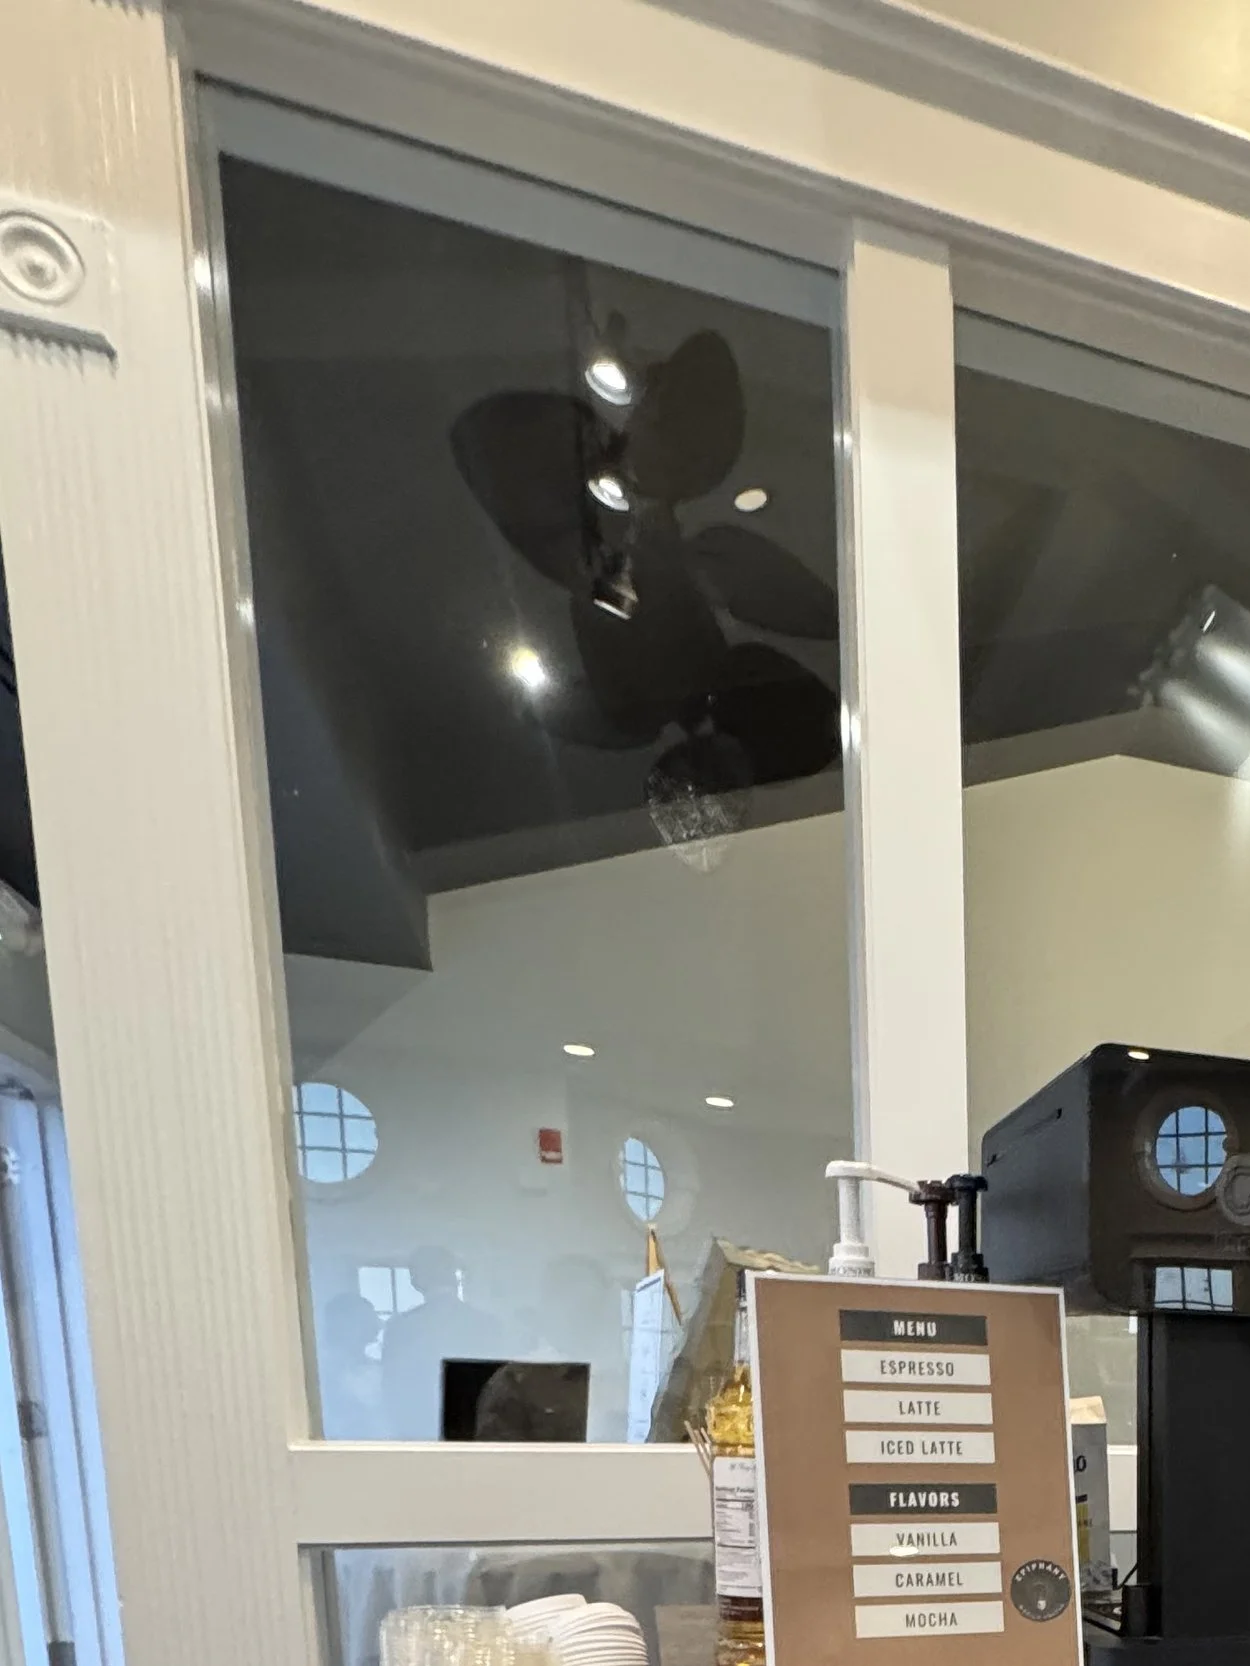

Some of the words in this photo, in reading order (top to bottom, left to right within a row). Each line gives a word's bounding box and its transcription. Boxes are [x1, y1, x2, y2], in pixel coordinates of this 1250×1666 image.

[893, 1319, 937, 1337] MENU
[880, 1359, 955, 1377] ESPRESSO
[899, 1400, 941, 1416] LATTE
[880, 1440, 915, 1455] ICED
[921, 1440, 964, 1456] LATTE
[889, 1491, 960, 1508] FLAVORS
[896, 1532, 958, 1548] VANILLA
[895, 1571, 964, 1588] CARAMEL
[1015, 1562, 1067, 1582] EPIPHANY
[905, 1612, 958, 1628] MOCHA
